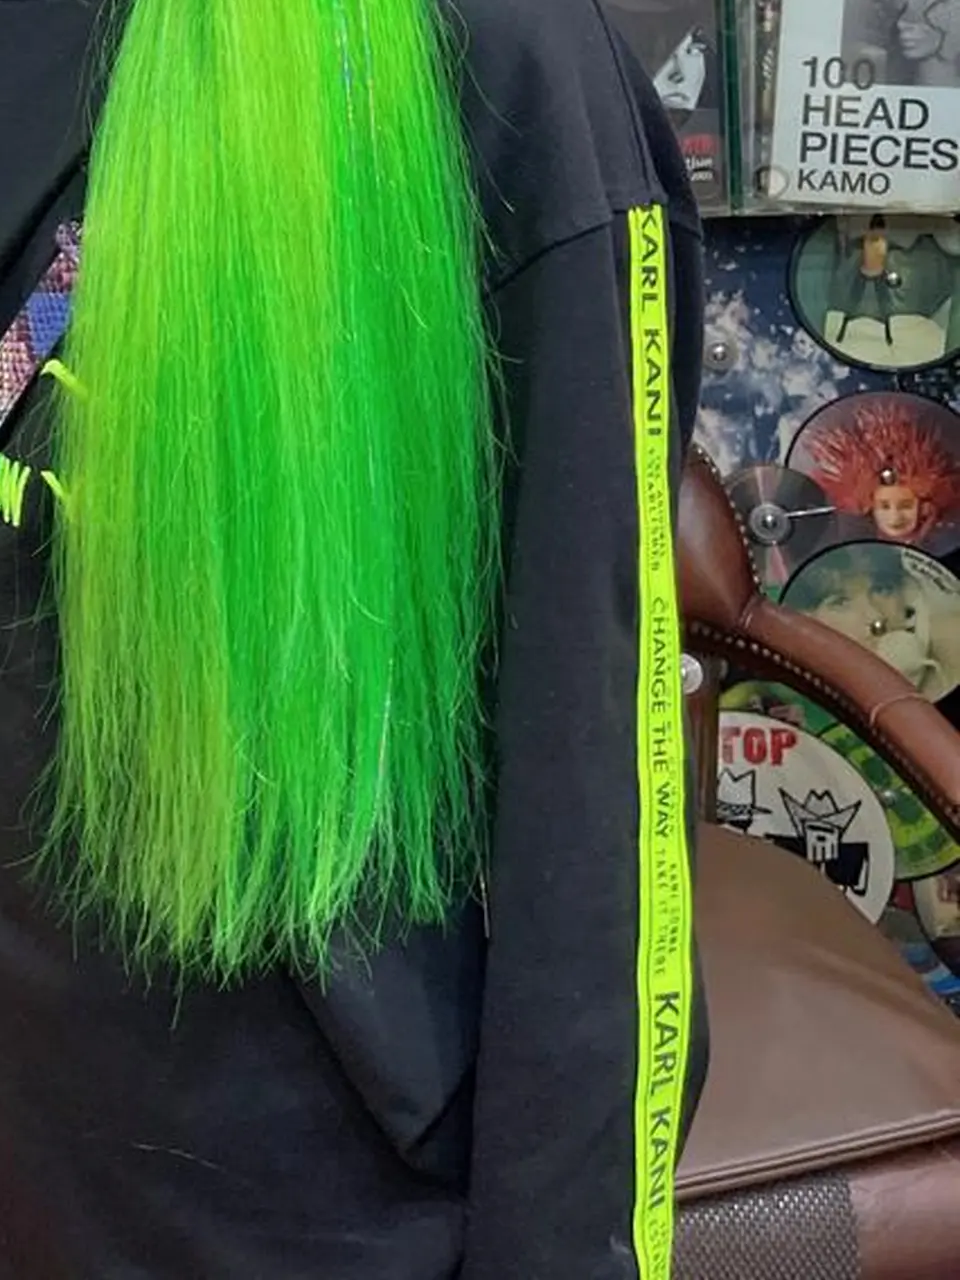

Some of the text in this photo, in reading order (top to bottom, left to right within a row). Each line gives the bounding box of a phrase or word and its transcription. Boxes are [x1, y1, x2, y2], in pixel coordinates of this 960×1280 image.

[803, 56, 876, 91] 100
[802, 93, 929, 131] HEAD
[799, 130, 959, 171] PIECES
[797, 168, 891, 195] KAMO
[640, 209, 662, 437] KARL KANI
[650, 597, 670, 840] CHANGE THE WAY
[719, 726, 797, 767] TOP
[650, 991, 680, 1096] KARL
[648, 1106, 672, 1210] KANI
